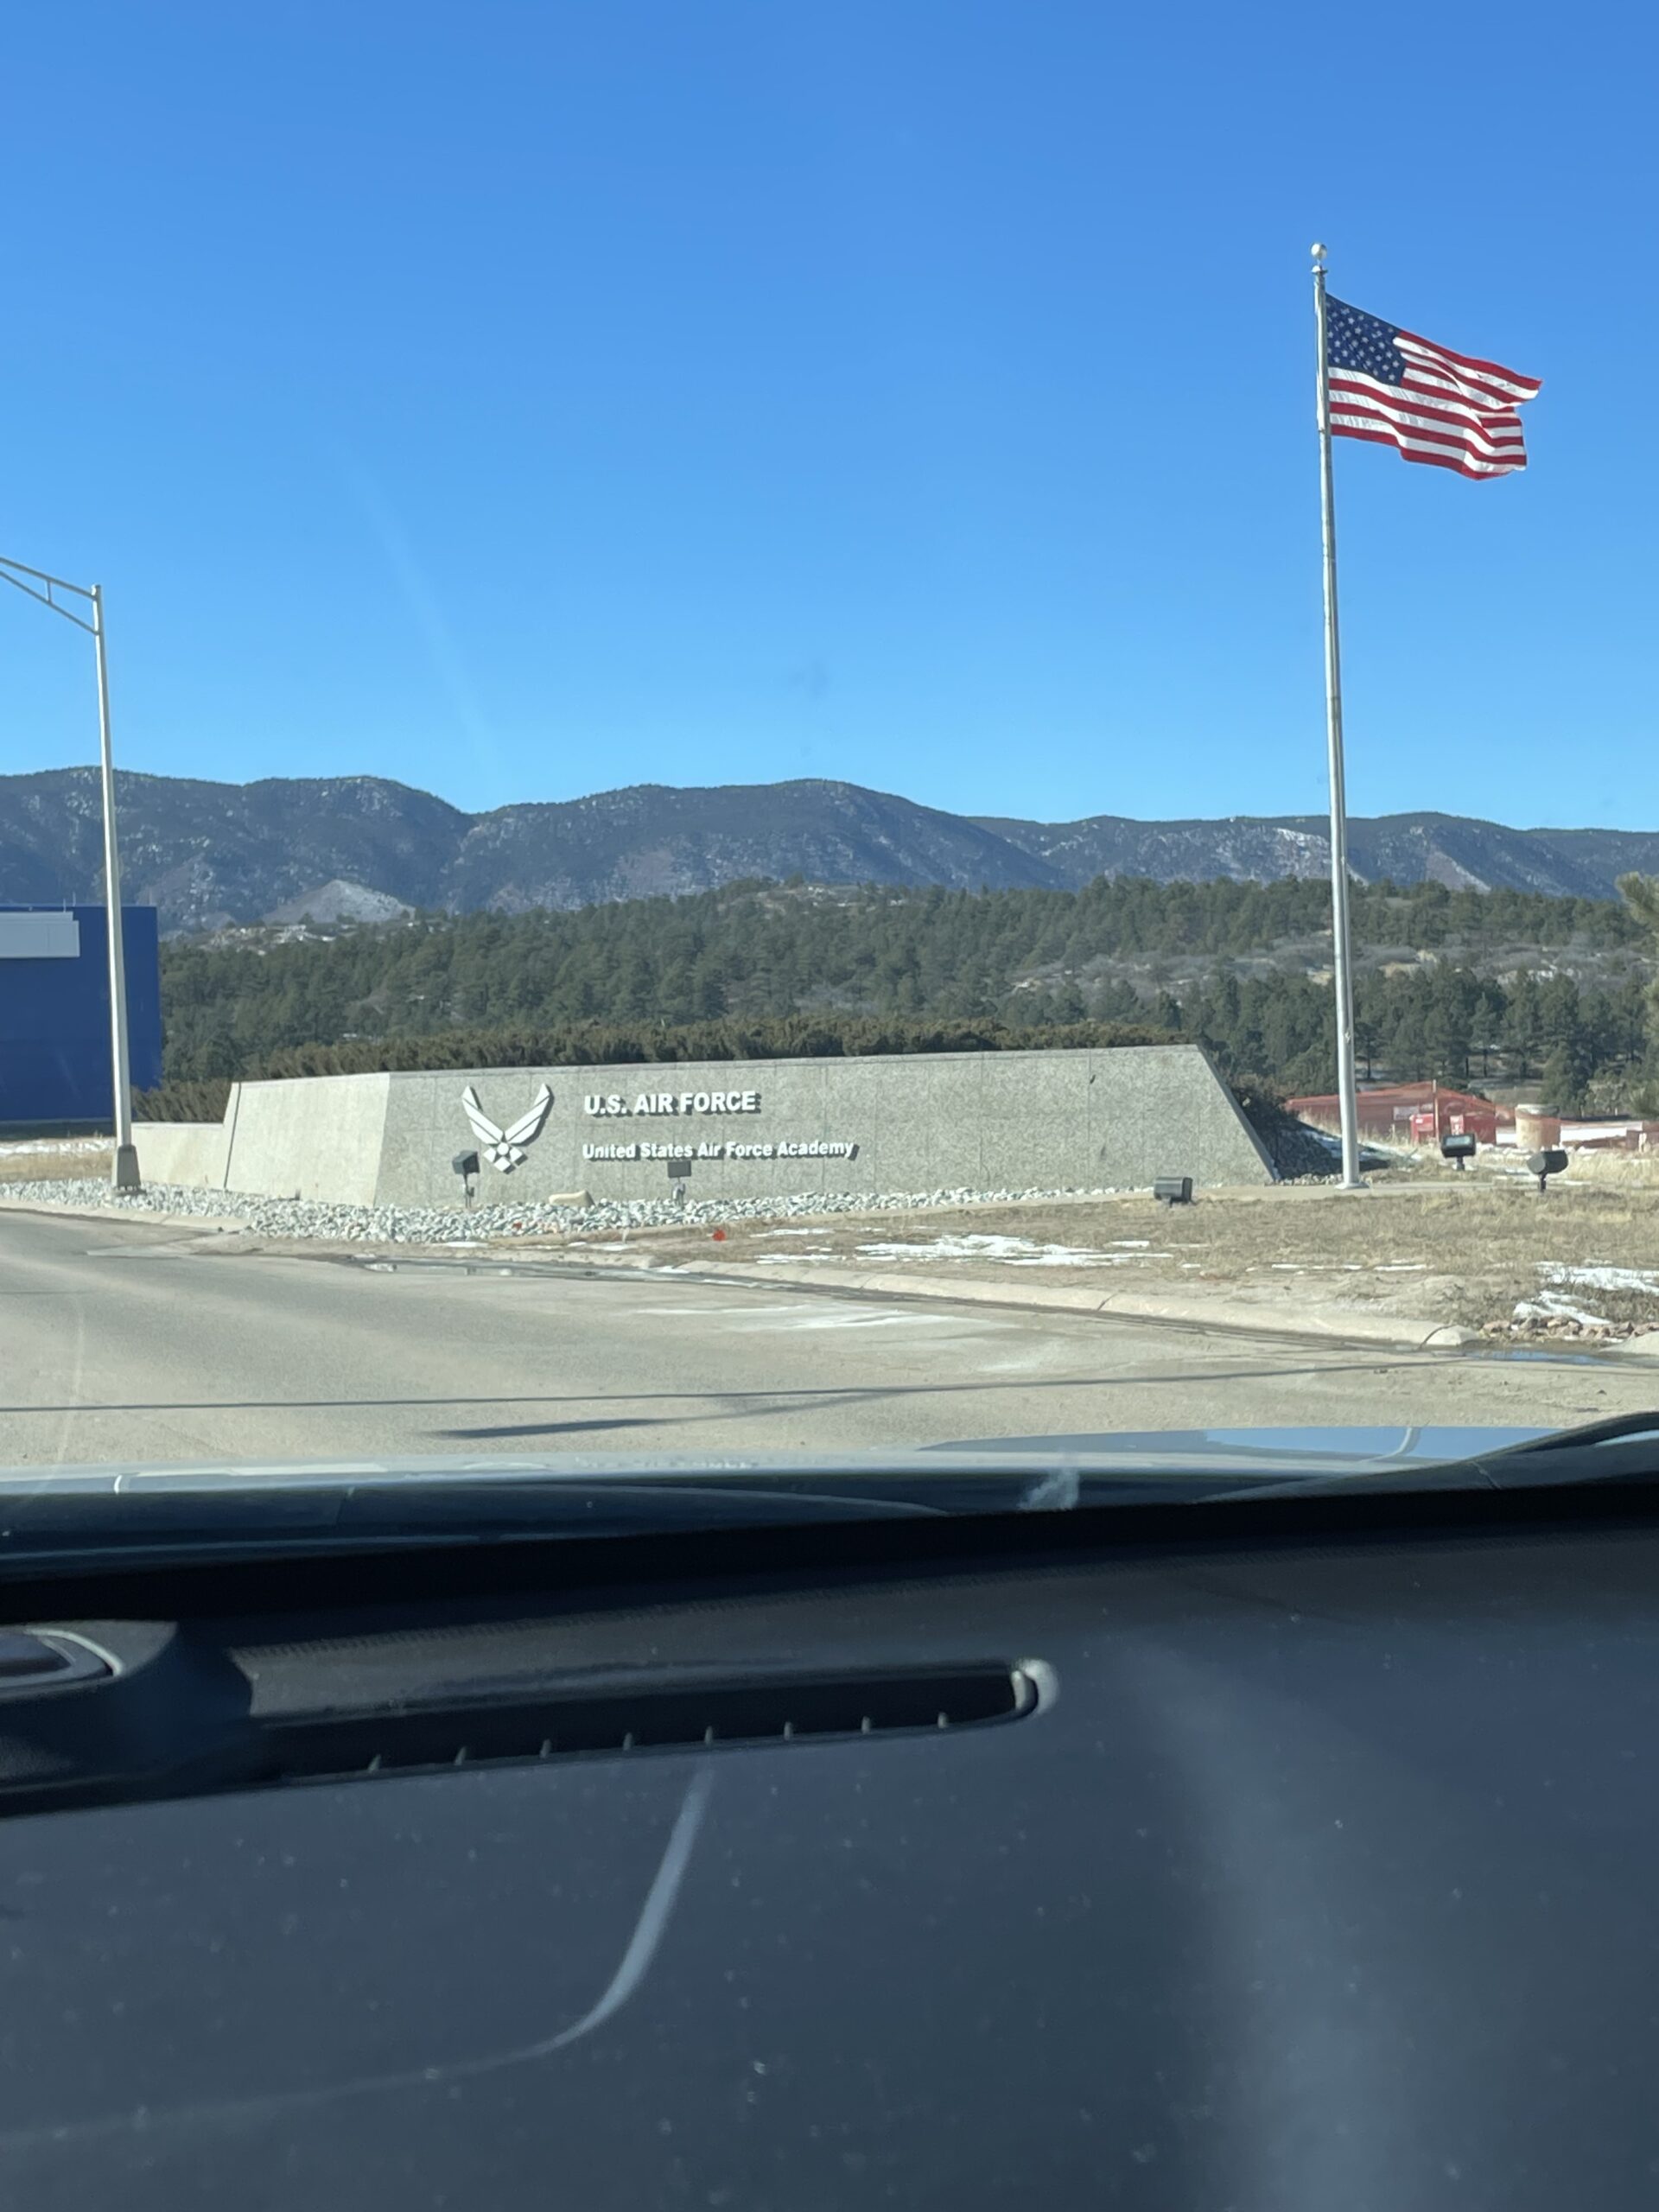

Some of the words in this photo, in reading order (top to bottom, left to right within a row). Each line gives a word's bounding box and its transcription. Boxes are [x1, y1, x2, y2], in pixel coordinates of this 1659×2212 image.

[584, 1094, 627, 1115] U.S.
[634, 1093, 674, 1113] AIR
[680, 1090, 756, 1112] FORCE
[582, 1143, 636, 1159] United
[640, 1142, 693, 1158] States
[697, 1141, 721, 1157] Air
[726, 1141, 772, 1157] Force
[778, 1139, 855, 1159] Academy
